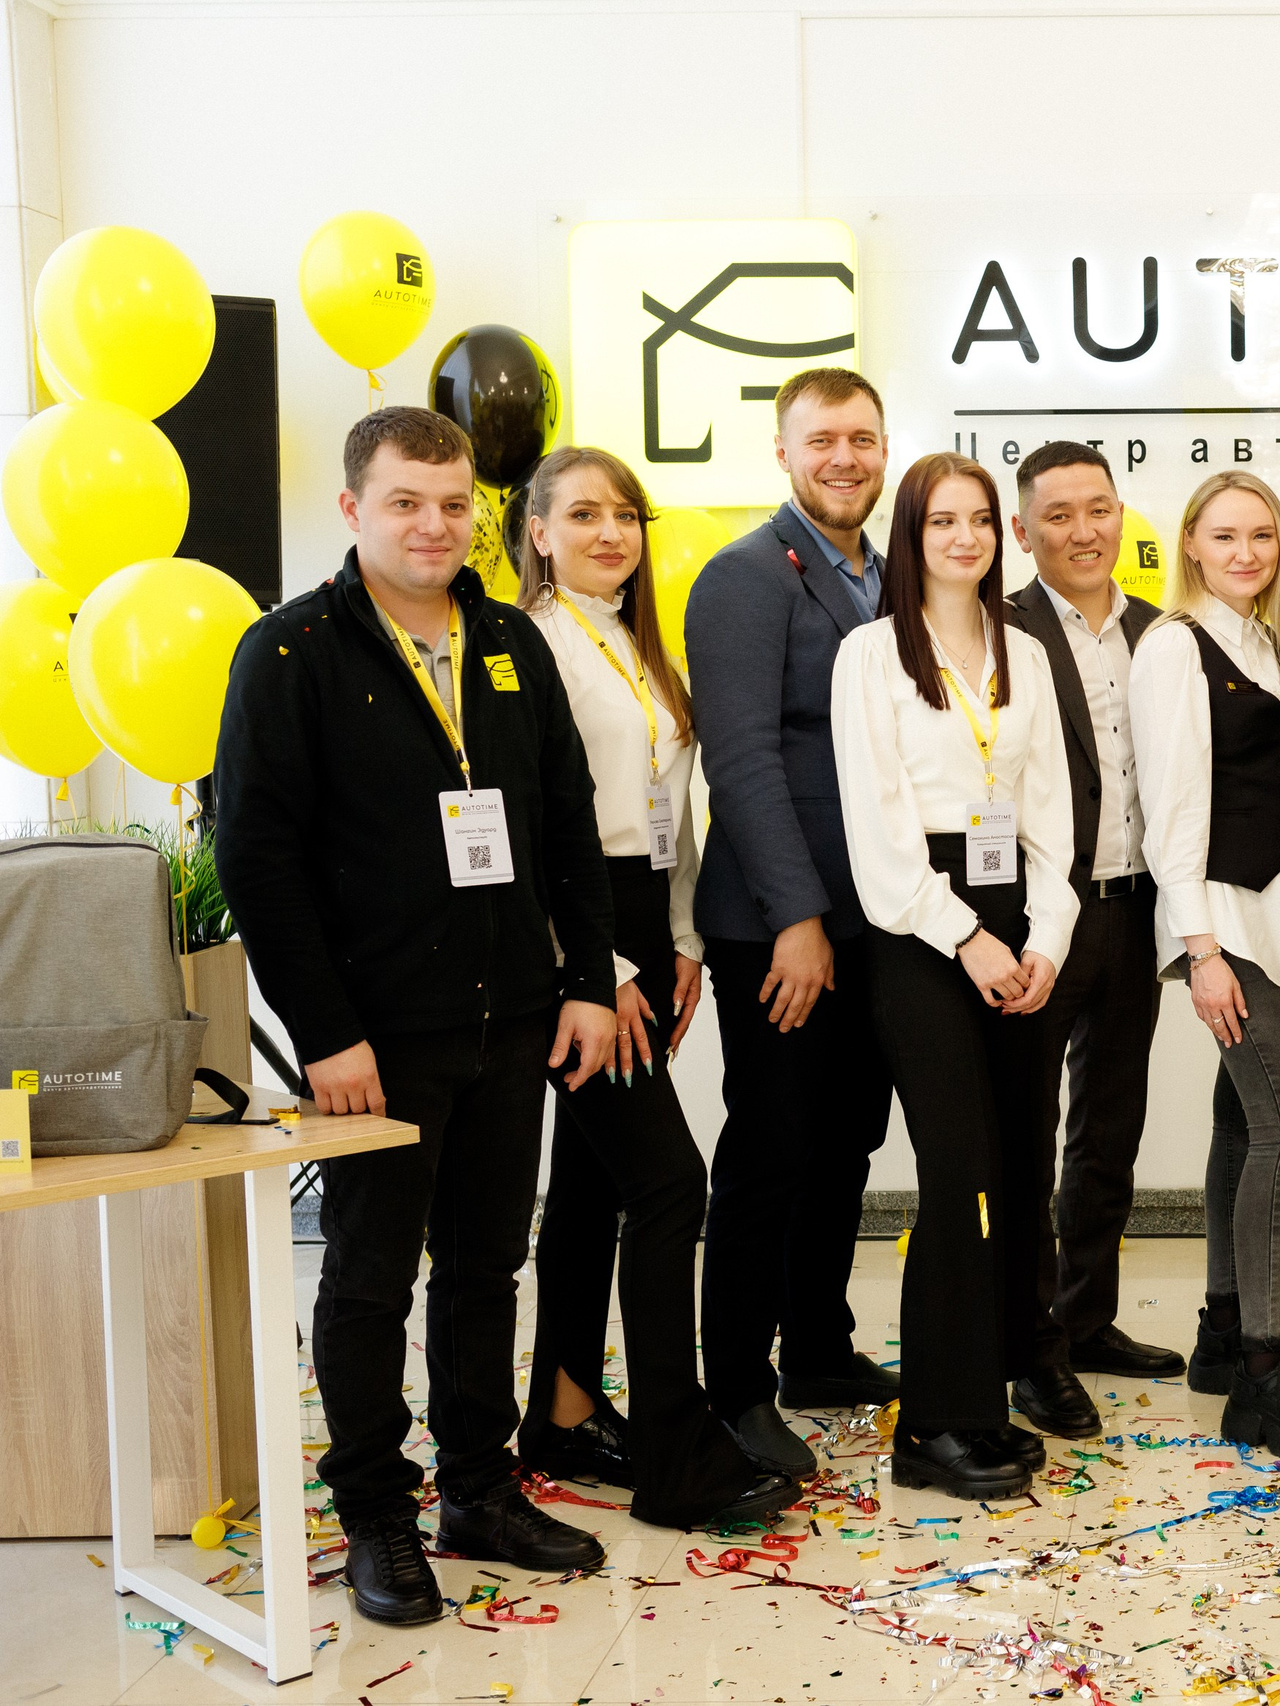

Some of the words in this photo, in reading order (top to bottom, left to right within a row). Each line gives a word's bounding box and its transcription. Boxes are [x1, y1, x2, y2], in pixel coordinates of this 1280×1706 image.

[373, 289, 432, 308] AUTOTIME
[397, 627, 417, 660] AUTOTIME
[452, 638, 460, 670] AUTOTIME
[604, 648, 626, 677] AUTOTIME
[943, 670, 963, 697] AUTOTIME
[43, 1071, 122, 1084] AUTOTIME
